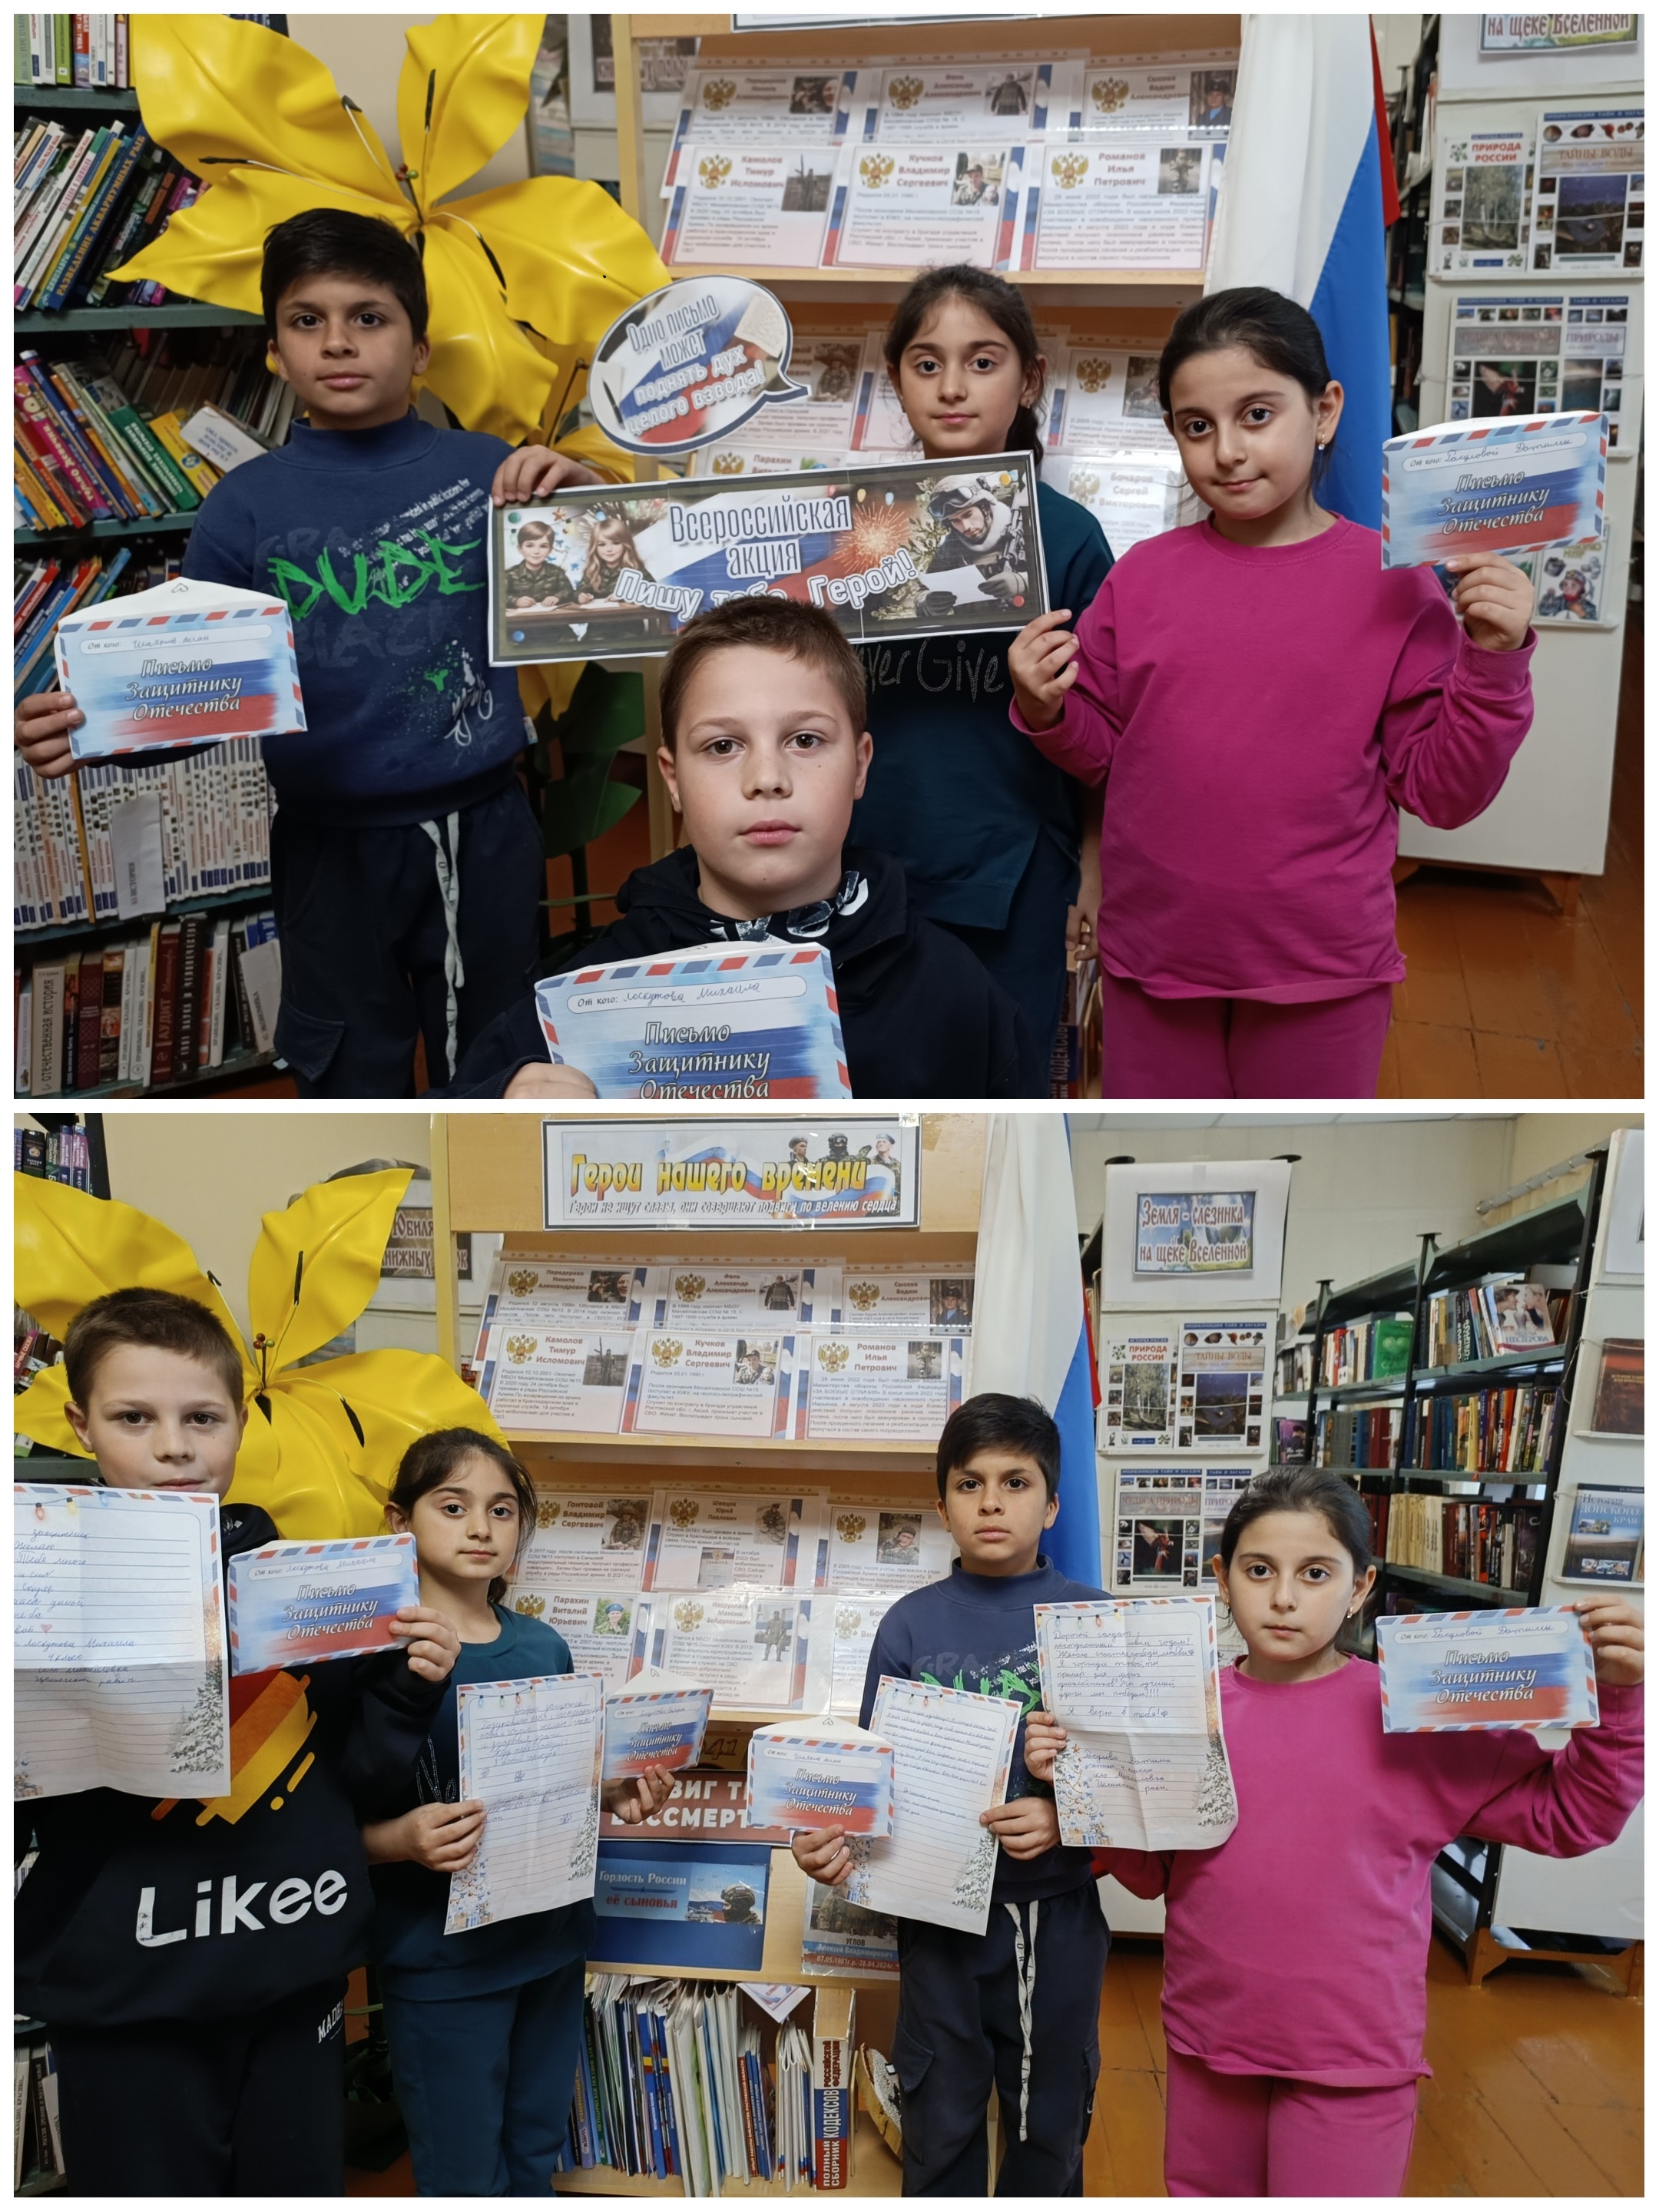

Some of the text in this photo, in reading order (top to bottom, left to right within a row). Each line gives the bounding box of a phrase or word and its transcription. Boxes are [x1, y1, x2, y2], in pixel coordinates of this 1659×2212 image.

[1472, 142, 1522, 152] ПРИРОДА
[909, 154, 943, 163] Кучков
[1099, 153, 1146, 161] Романов
[1475, 154, 1517, 162] РОССИИ
[899, 167, 950, 175] Владимир
[1094, 178, 1145, 187] Петрович
[634, 346, 747, 406] поднять дух
[628, 397, 689, 435] целого
[692, 361, 765, 409] взвода!
[1455, 472, 1525, 493] Письмо
[1438, 487, 1550, 516] Защитнику
[671, 497, 849, 543] Всероссийская
[1442, 507, 1543, 535] Отечества
[728, 541, 800, 578] акция
[267, 529, 485, 621] DUDE
[615, 549, 917, 621] Пишу Герой!
[141, 658, 213, 678] Письмо
[917, 636, 1004, 703] Give
[126, 676, 242, 701] Защитнику
[132, 695, 240, 721] Отечества
[578, 998, 592, 1008] От
[595, 996, 618, 1005] кого:
[644, 1021, 730, 1045] Письмо
[629, 1051, 770, 1079] Защитнику
[640, 1078, 769, 1098] Отечества
[571, 1154, 867, 1200] Герои нашего времени
[601, 1201, 613, 1213] не
[680, 1201, 697, 1212] они
[800, 1200, 812, 1212] по
[545, 1336, 583, 1344] Камолов
[695, 1339, 725, 1348] Кучков
[549, 1346, 576, 1356] Тимур
[687, 1349, 731, 1358] Владимир
[536, 1356, 584, 1366] Исломович
[685, 1359, 730, 1369] Сергеевич
[563, 1511, 604, 1519] Владимир
[297, 1584, 356, 1601] Письмо
[554, 1596, 589, 1604] Парахин
[283, 1599, 378, 1621] Защитнику
[287, 1617, 373, 1640] Отечества
[548, 1617, 587, 1626] Юрьевич
[1445, 1651, 1509, 1666] Письмо
[1430, 1668, 1537, 1688] Защитнику
[1436, 1686, 1534, 1704] Отечества
[638, 1722, 672, 1734] Письмо
[627, 1734, 682, 1749] Защитнику
[627, 1744, 677, 1761] Отечества
[795, 1768, 840, 1784] Письмо
[783, 1783, 857, 1803] Защитнику
[786, 1798, 853, 1816] Отечества
[599, 1870, 687, 1886] Гордость России
[135, 1869, 347, 1948] Likee
[606, 1896, 677, 1909] её сыновья
[846, 1937, 866, 1946] УГЛОВ
[833, 2041, 841, 2087] ФЕДЕРАЦИИ
[823, 2090, 841, 2137] КОДЕКСОВ
[822, 2141, 830, 2186] ПОЛНЫЙ
